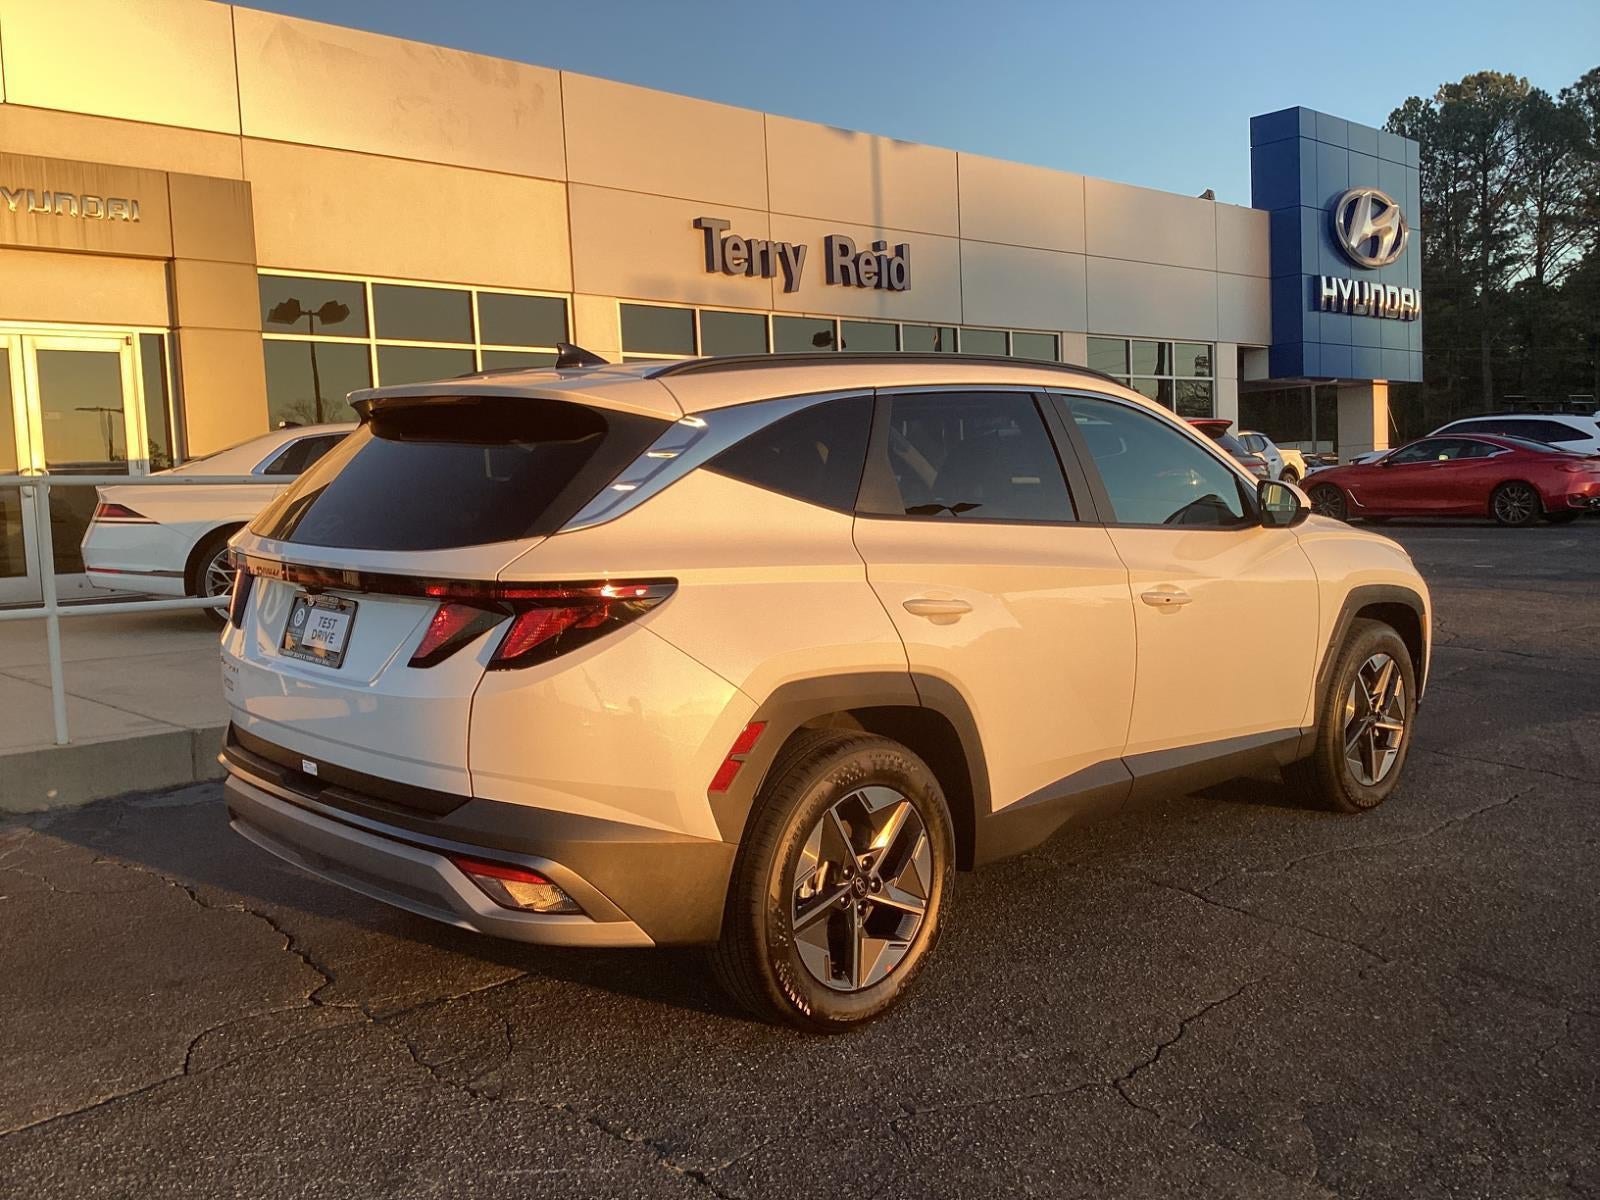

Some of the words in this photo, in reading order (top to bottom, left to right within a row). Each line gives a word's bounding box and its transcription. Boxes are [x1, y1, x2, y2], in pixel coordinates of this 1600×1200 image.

[693, 217, 807, 293] Terry
[824, 234, 911, 291] Reid
[1319, 275, 1422, 321] HYUNDAI
[311, 630, 335, 644] DRIVE
[318, 615, 338, 629] TEST
